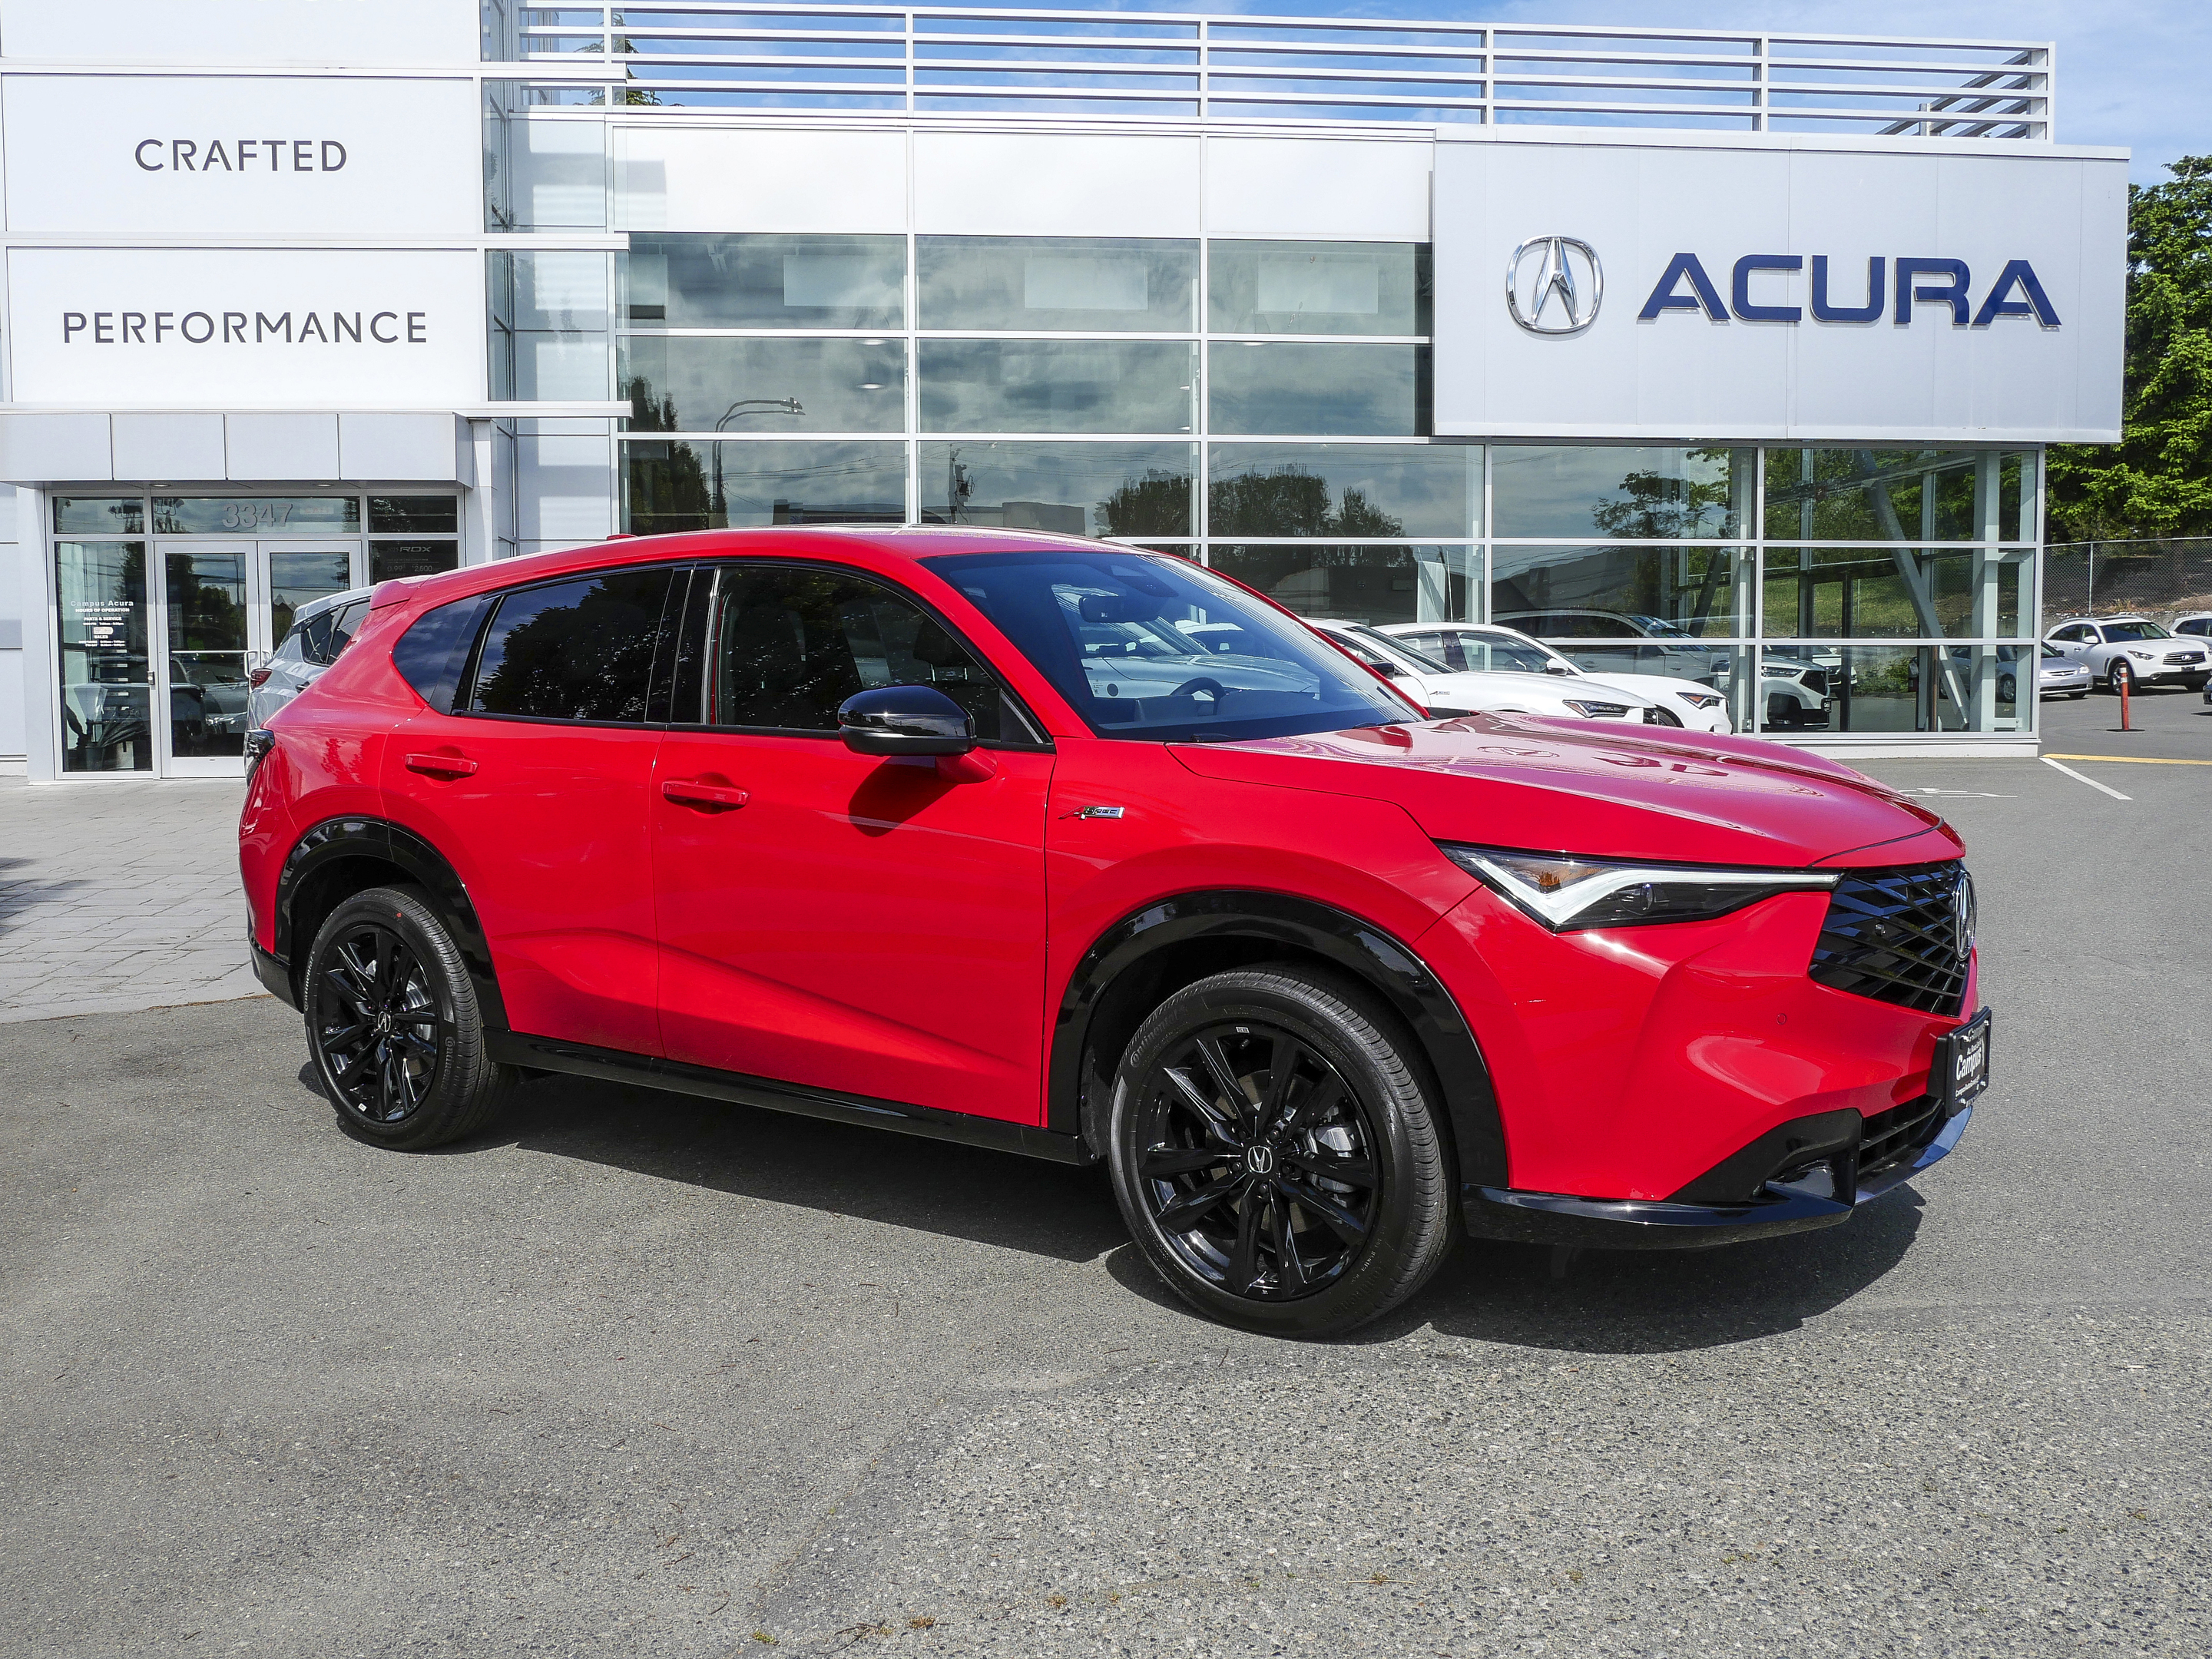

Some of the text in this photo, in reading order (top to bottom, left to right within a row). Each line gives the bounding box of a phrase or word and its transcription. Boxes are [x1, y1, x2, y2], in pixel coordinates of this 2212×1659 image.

[134, 138, 347, 172] CRAFTED
[1637, 252, 2061, 327] ACURA
[63, 311, 427, 344] PERFORMANCE
[222, 503, 293, 528] 3347
[1955, 1046, 1982, 1081] Campus
